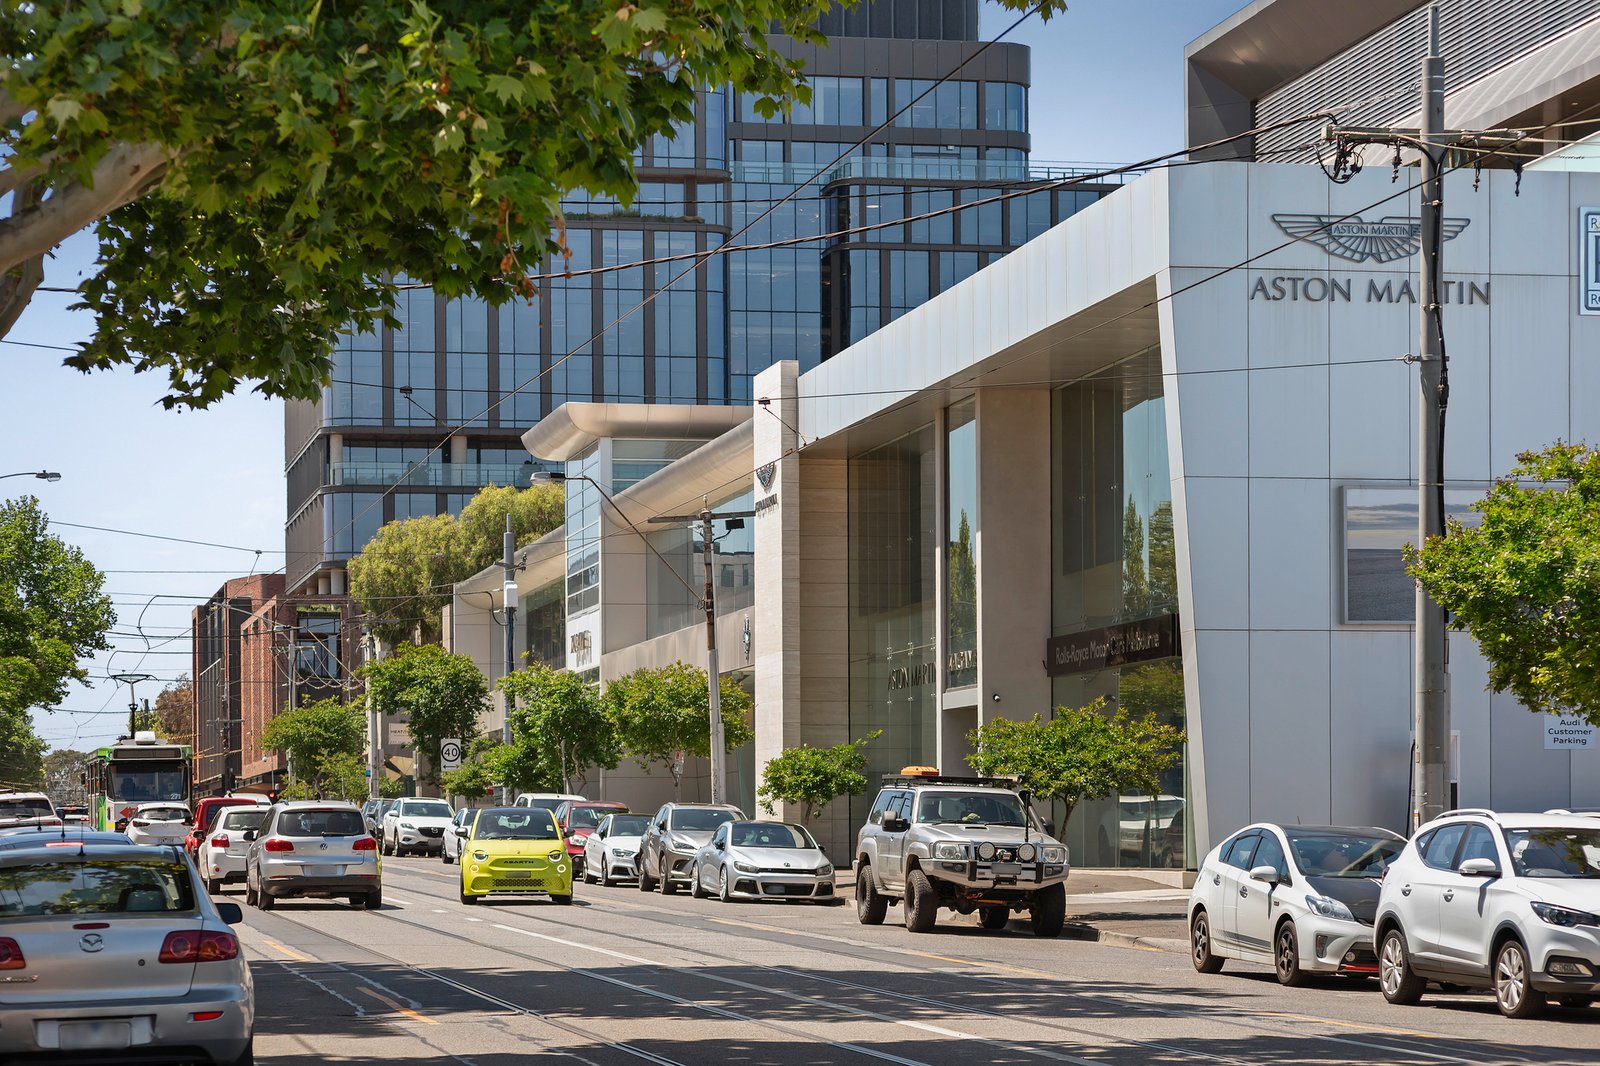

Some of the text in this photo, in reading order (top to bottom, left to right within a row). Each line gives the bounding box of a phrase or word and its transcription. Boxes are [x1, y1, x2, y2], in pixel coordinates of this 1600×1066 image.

[1333, 225, 1411, 236] ASTON MARTIN
[1250, 276, 1490, 305] ASTON MATIN
[1553, 737, 1587, 745] Parking
[444, 748, 458, 757] 40
